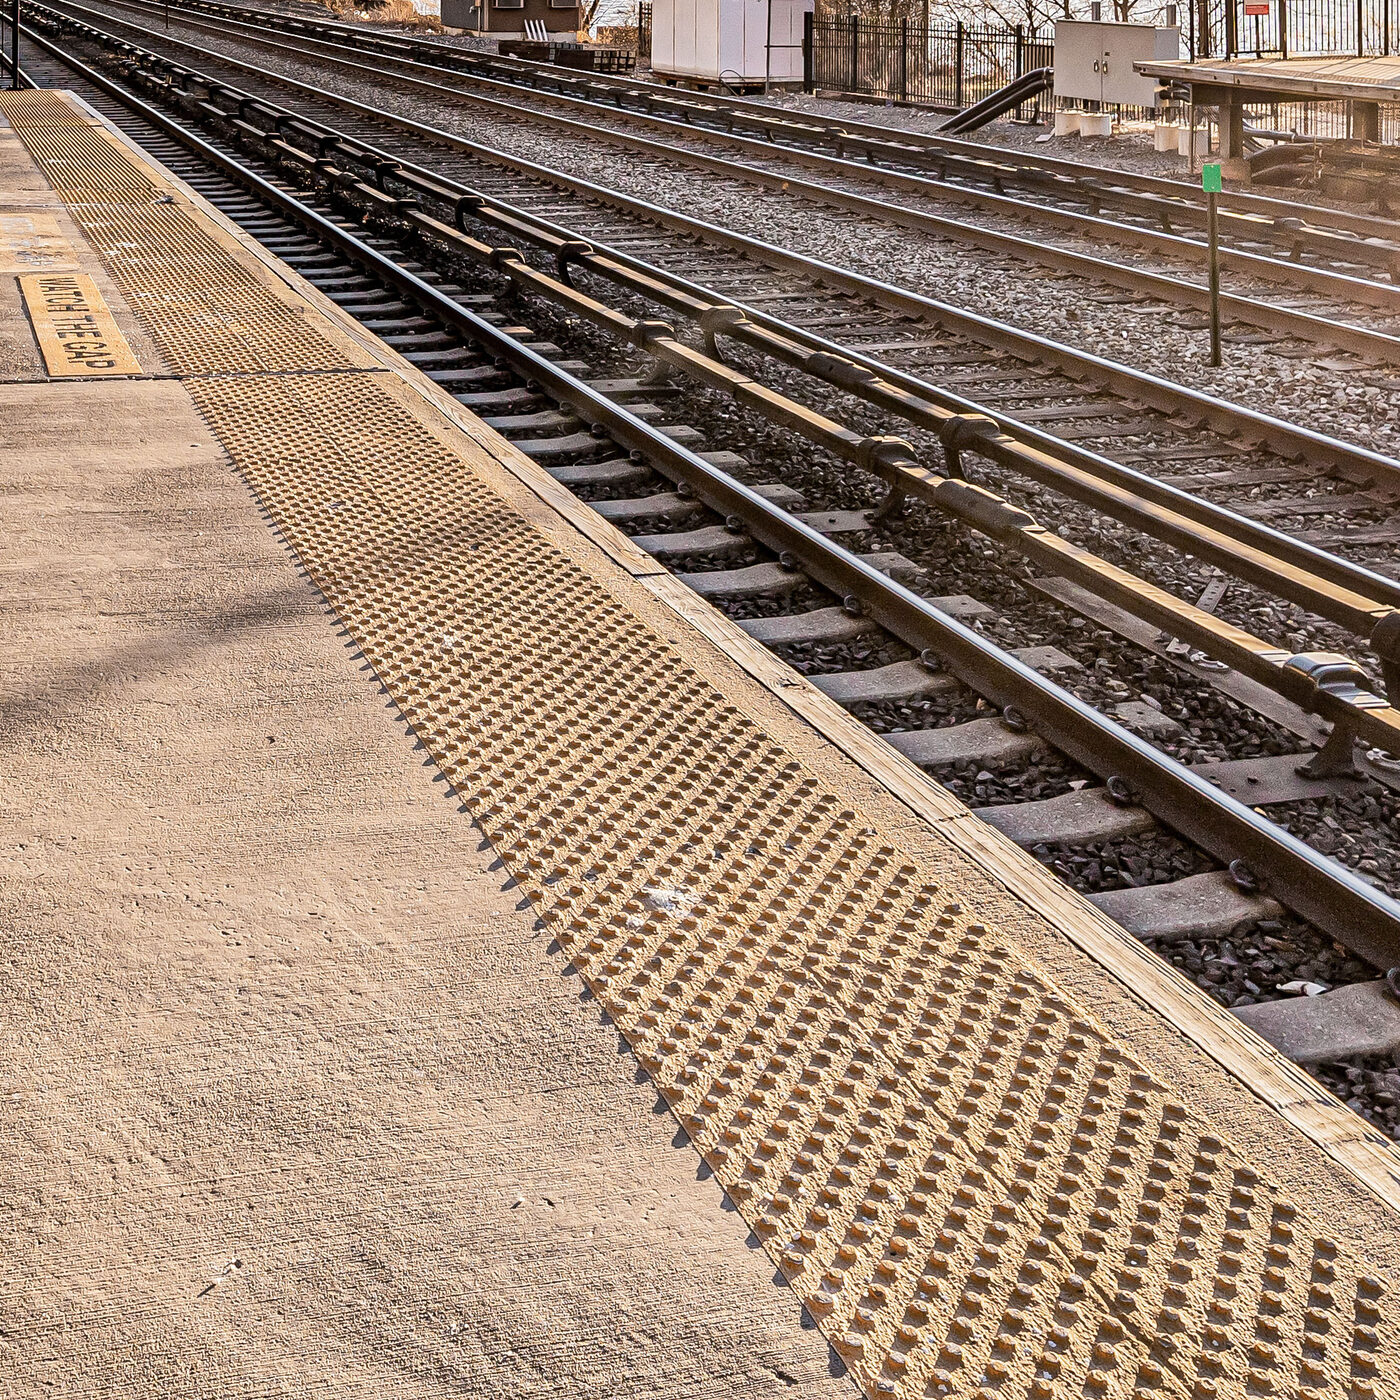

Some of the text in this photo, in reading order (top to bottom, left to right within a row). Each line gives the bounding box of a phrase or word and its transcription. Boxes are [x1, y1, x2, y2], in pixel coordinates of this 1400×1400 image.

[38, 276, 116, 369] WATCH THE GAP
